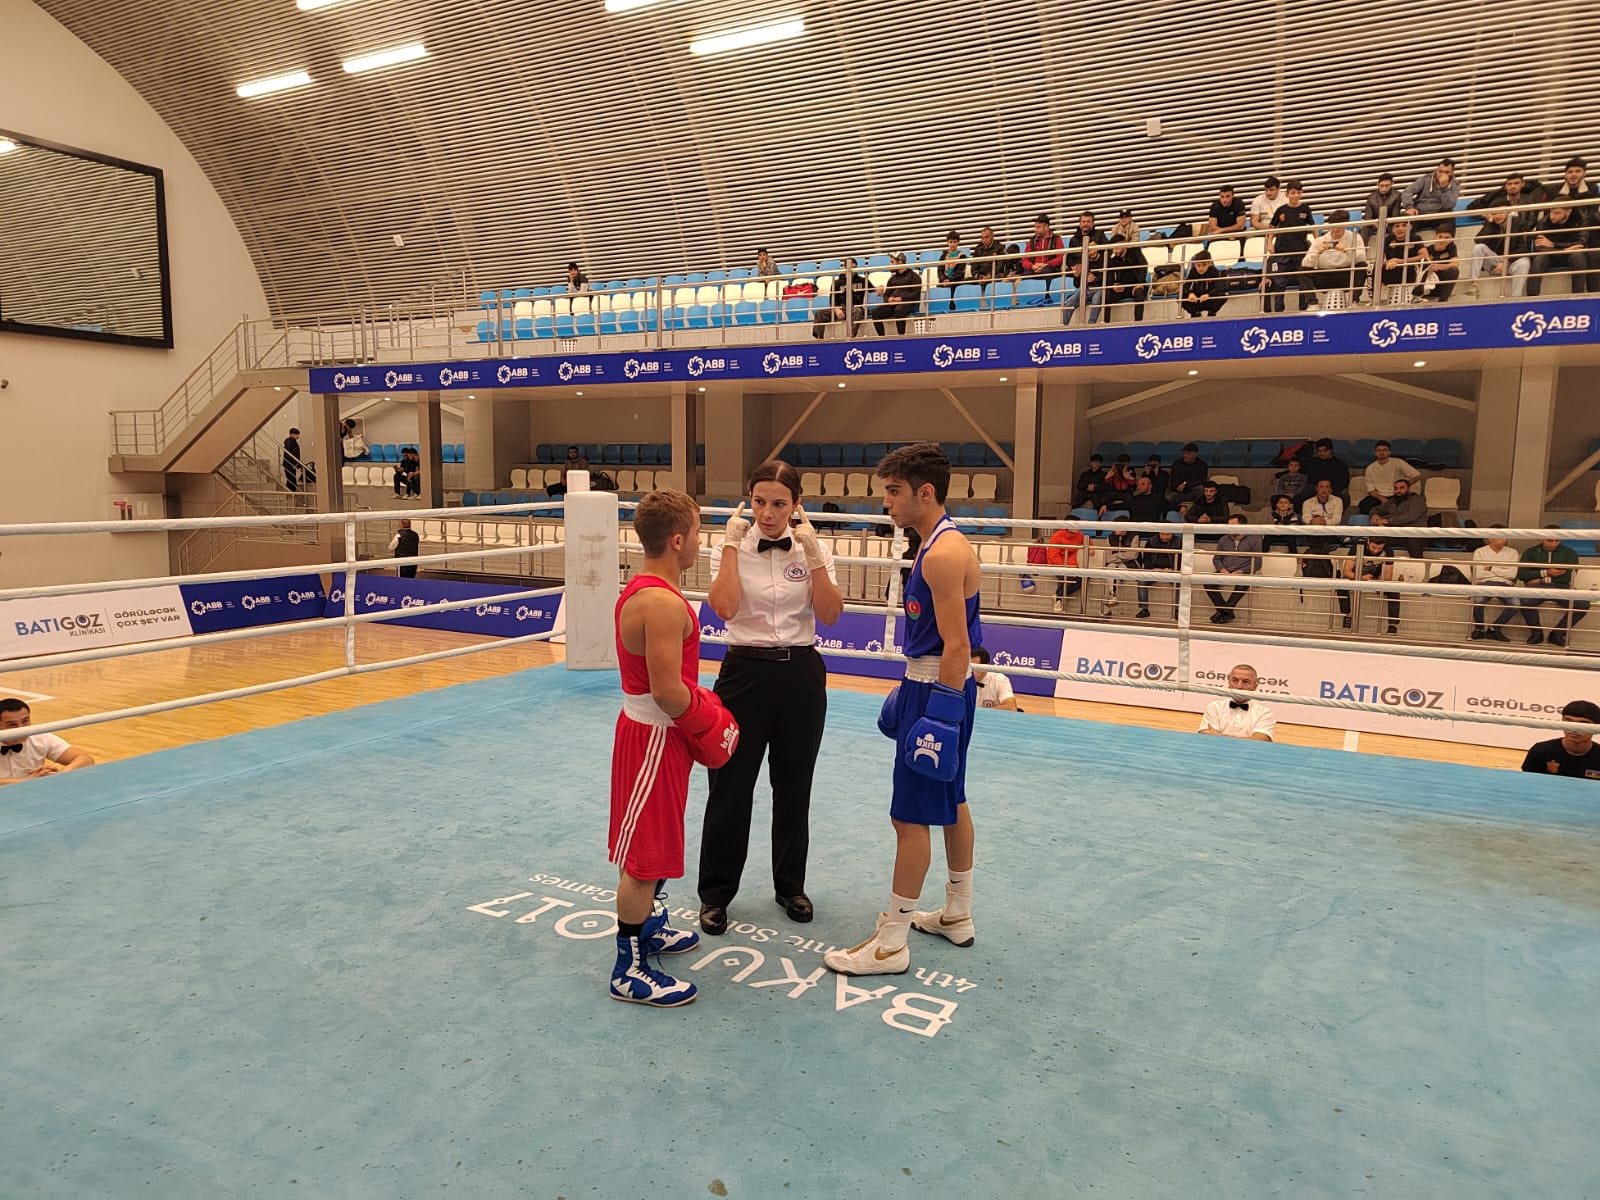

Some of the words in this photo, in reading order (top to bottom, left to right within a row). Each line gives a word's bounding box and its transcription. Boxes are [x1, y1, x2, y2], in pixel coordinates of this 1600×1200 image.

[1546, 314, 1591, 330] ABB
[1400, 322, 1439, 337] ABB
[1269, 329, 1304, 343] ABB
[1161, 336, 1194, 349] ABB
[954, 348, 981, 360] ABB
[1053, 343, 1082, 355] ABB
[781, 355, 804, 366] ABB
[864, 351, 889, 362] ABB
[573, 364, 592, 375] ABB
[640, 361, 660, 372] ABB
[704, 358, 726, 370] ABB
[397, 373, 413, 382] ABB
[452, 370, 469, 380] ABB
[510, 367, 529, 378] ABB
[345, 375, 361, 384] ABB
[160, 614, 180, 623] VAR
[823, 639, 843, 649] ABB
[1012, 656, 1036, 666] ABB
[528, 873, 618, 903] Games
[464, 891, 619, 940] 017
[915, 967, 978, 994] 4th
[688, 946, 959, 1038] BAKU
